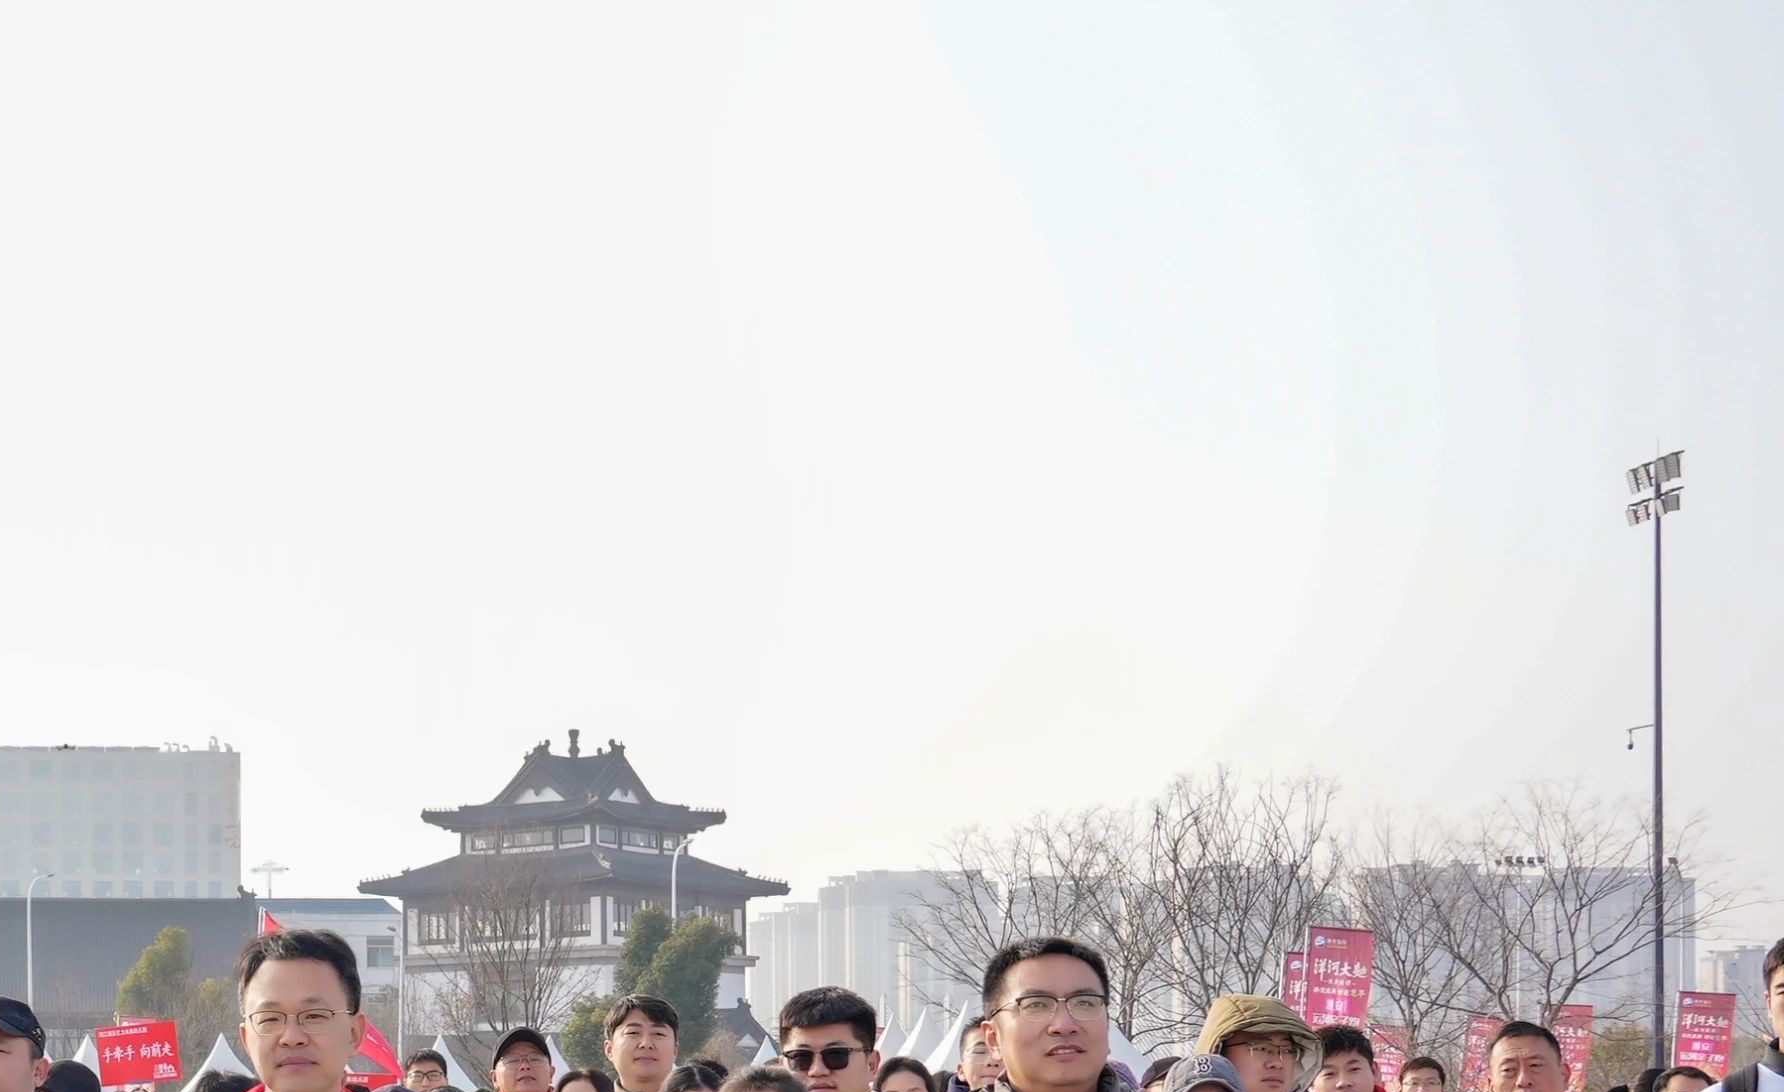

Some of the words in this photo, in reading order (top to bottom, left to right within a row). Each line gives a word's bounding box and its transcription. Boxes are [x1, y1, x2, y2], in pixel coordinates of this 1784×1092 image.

[102, 1044, 136, 1063] 手牵手
[139, 1040, 176, 1059] 向前走
[1194, 1056, 1212, 1074] B
